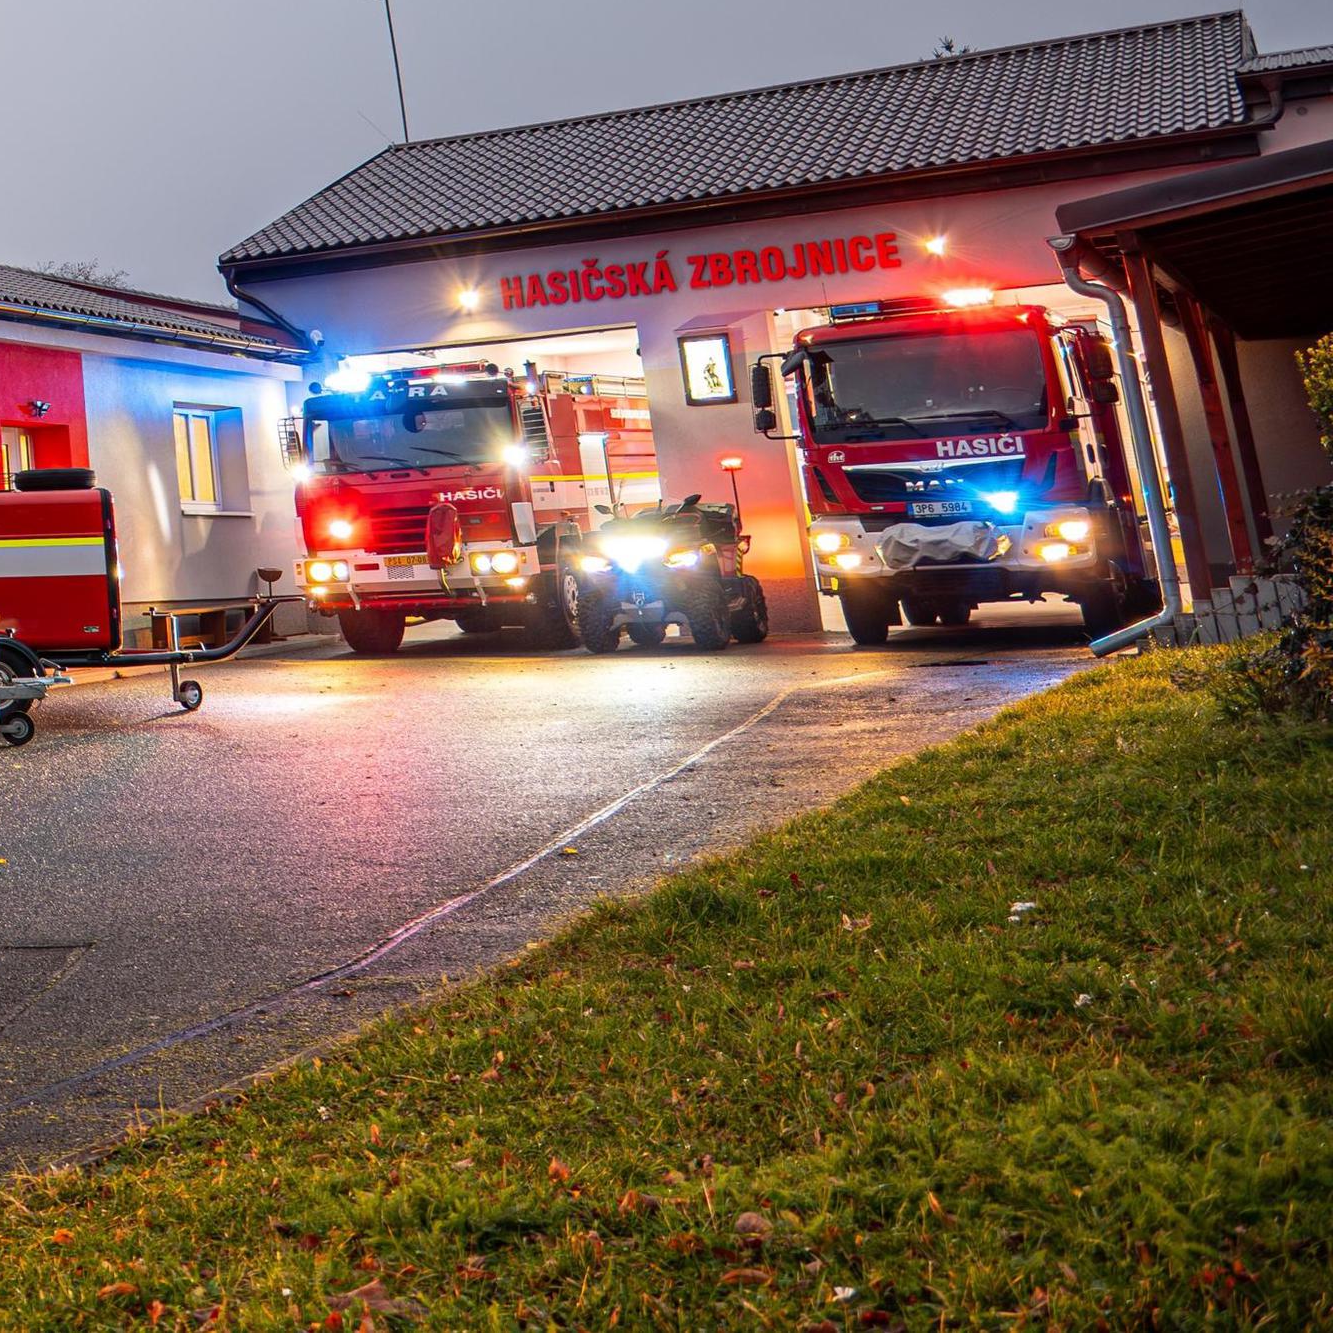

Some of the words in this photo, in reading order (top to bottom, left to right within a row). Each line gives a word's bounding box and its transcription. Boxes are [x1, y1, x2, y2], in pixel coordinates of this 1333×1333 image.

[499, 250, 676, 311] HASIČSKÁ
[686, 232, 902, 289] ZBROJNICE
[936, 433, 1024, 457] HASIČI
[439, 486, 503, 502] HASIČI
